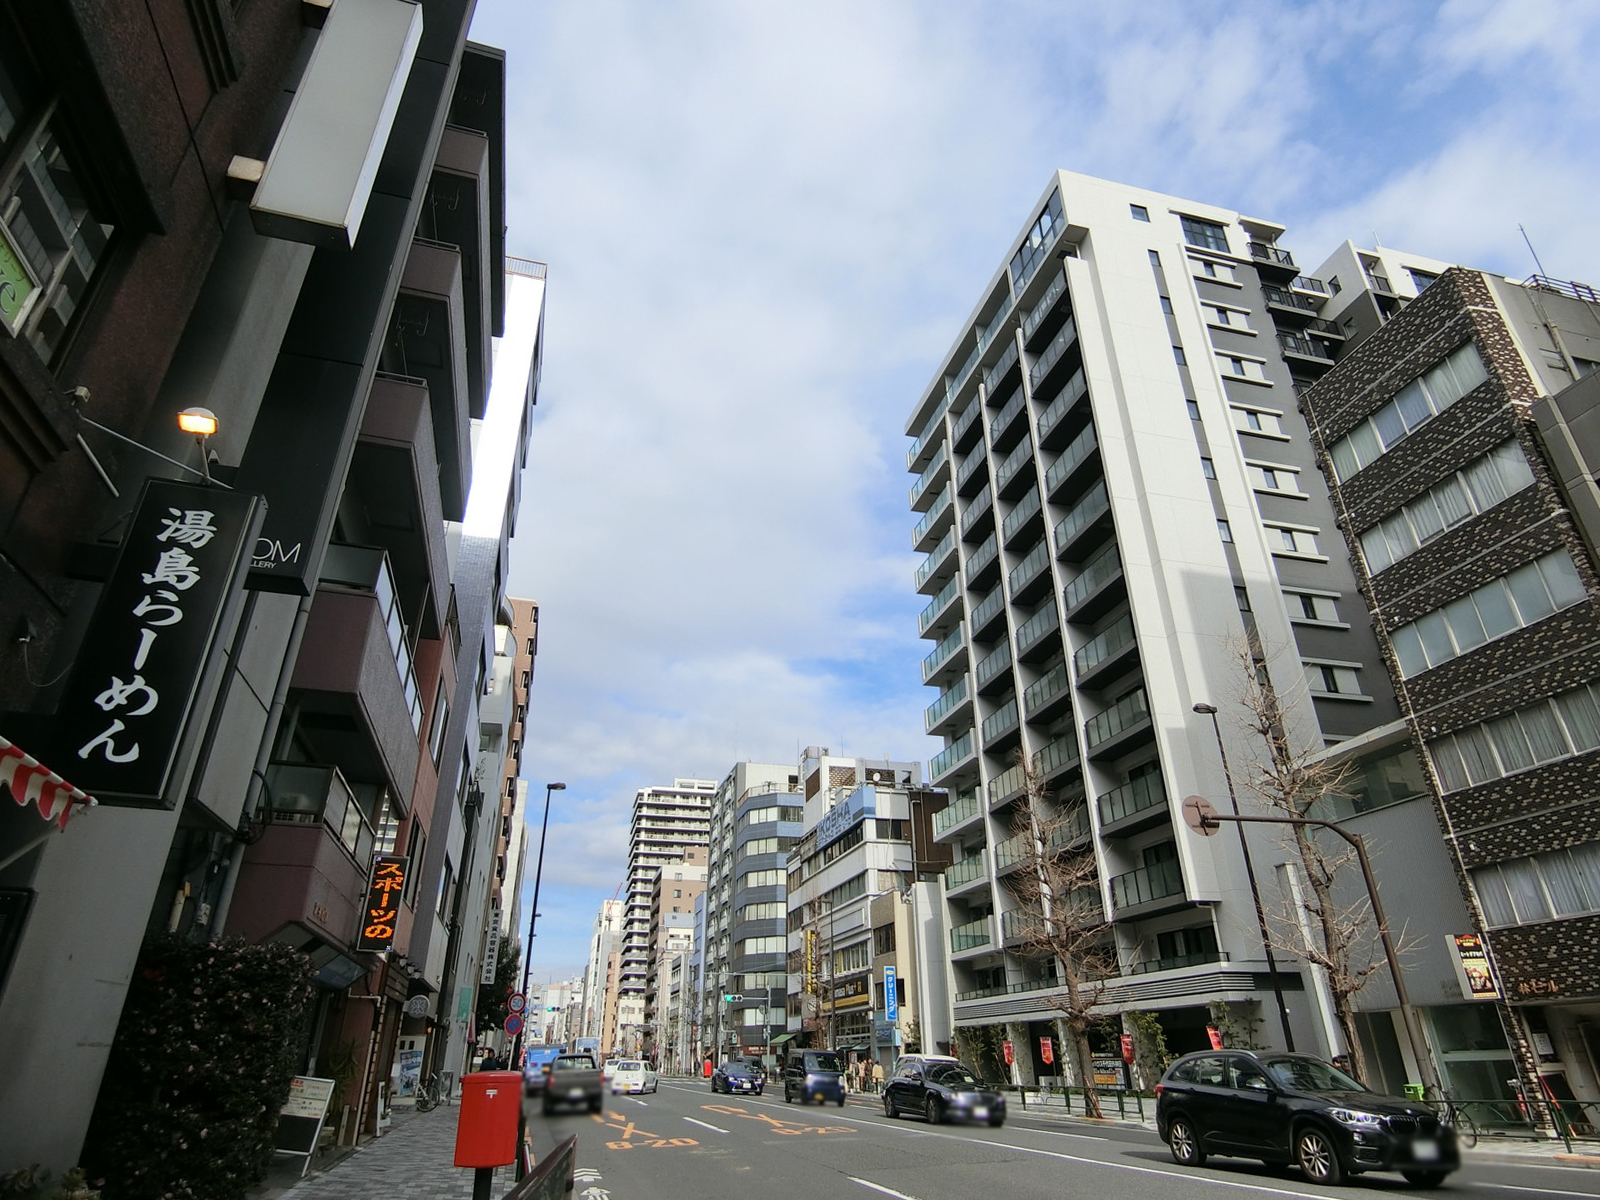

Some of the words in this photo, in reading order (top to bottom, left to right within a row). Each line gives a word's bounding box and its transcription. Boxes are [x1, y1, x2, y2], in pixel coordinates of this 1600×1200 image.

[77, 506, 217, 764] 湯島らーめん
[364, 862, 404, 939] スポーツの
[512, 998, 523, 1009] 50
[887, 976, 898, 1014] クリーニング
[604, 1137, 700, 1150] 8-20
